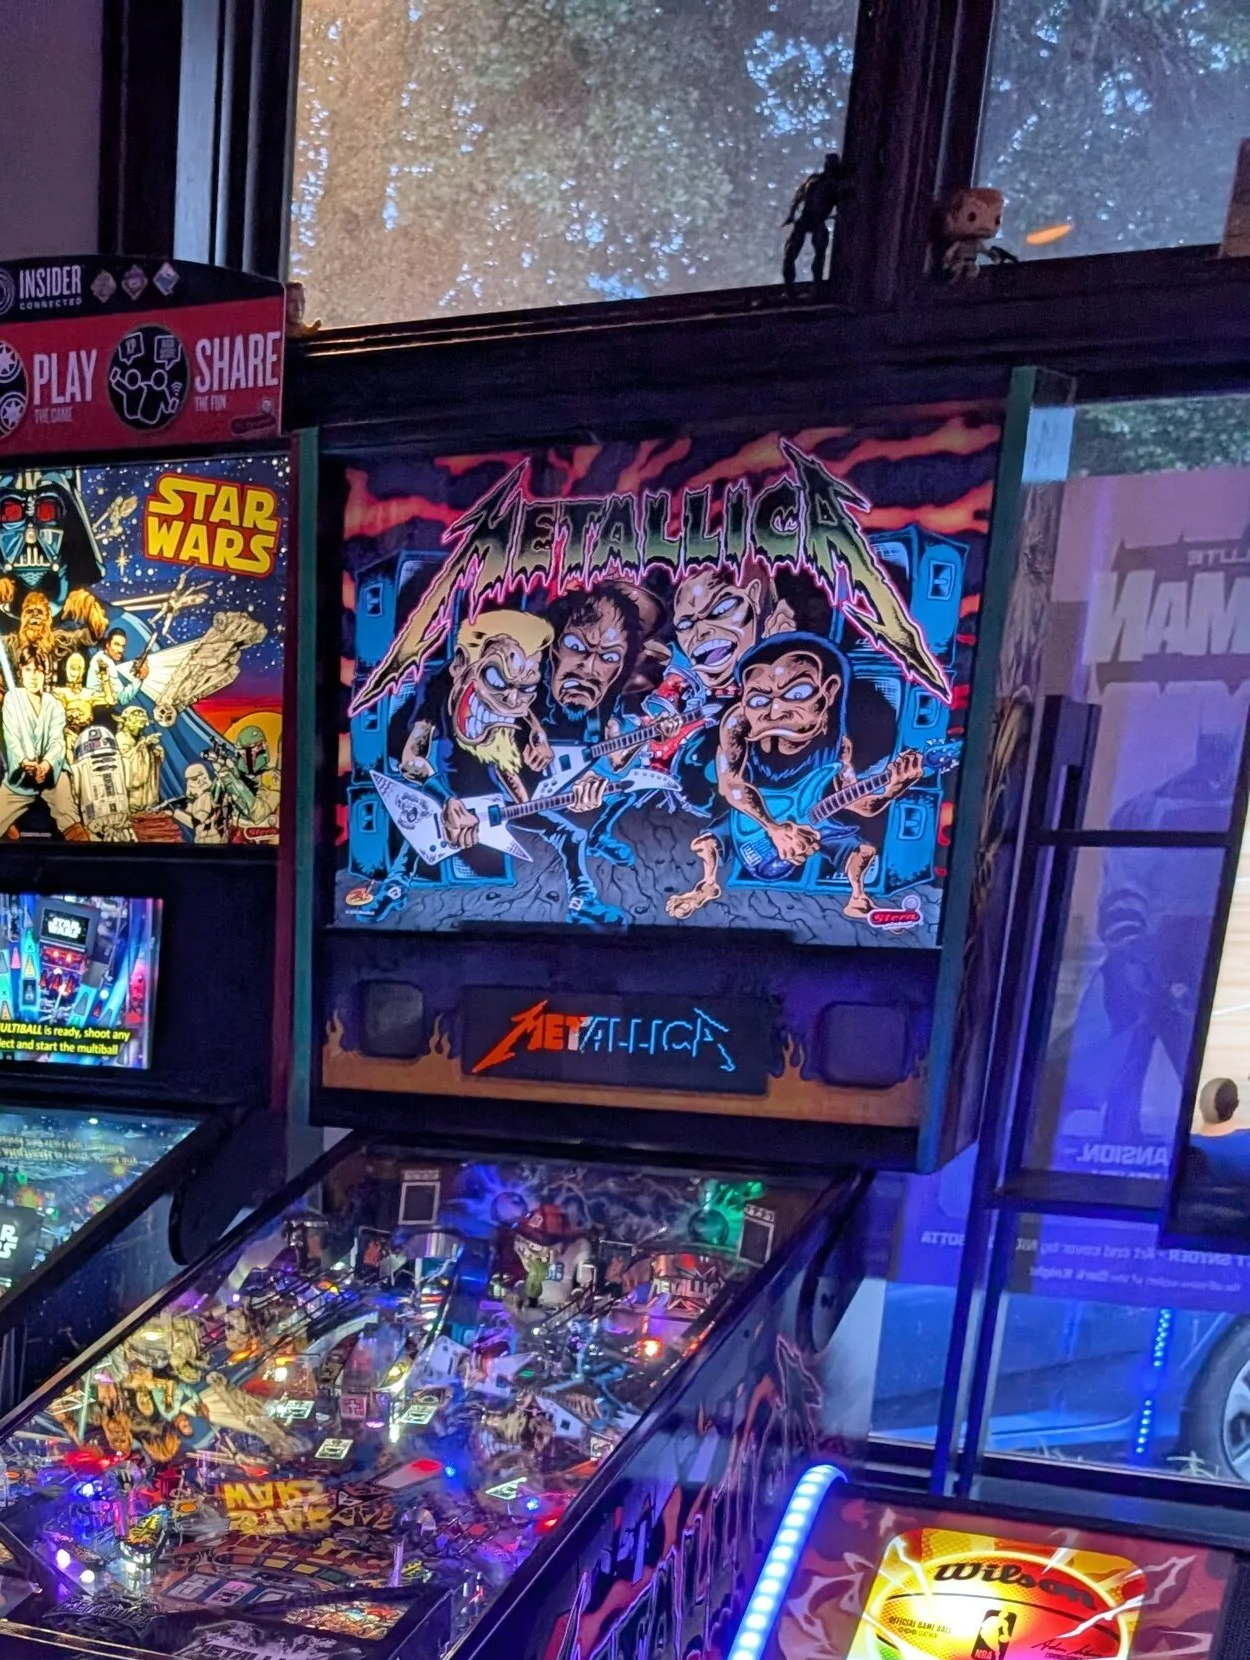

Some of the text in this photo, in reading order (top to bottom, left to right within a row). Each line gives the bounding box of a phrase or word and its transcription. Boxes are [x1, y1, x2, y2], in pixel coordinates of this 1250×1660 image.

[19, 265, 82, 299] INSIDER
[19, 298, 82, 310] CONNECTED
[32, 349, 98, 405] PLAY
[194, 331, 281, 393] SHARE
[34, 408, 49, 424] THE
[195, 395, 227, 412] THE FUN
[148, 476, 278, 532] STAR
[147, 516, 276, 574] WARS
[349, 438, 953, 717] METALLICA
[16, 1039, 33, 1050] and
[35, 1041, 57, 1051] start
[59, 1041, 75, 1052] the
[77, 1042, 118, 1055] multiball
[44, 1025, 52, 1035] is
[53, 1026, 82, 1040] ready,
[84, 1028, 110, 1039] shoot
[112, 1031, 130, 1042] any
[472, 1000, 736, 1074] METALLICA
[933, 1561, 1097, 1611] Wilson
[888, 1615, 916, 1628] OFFICIAL
[974, 1648, 993, 1660] NBA
